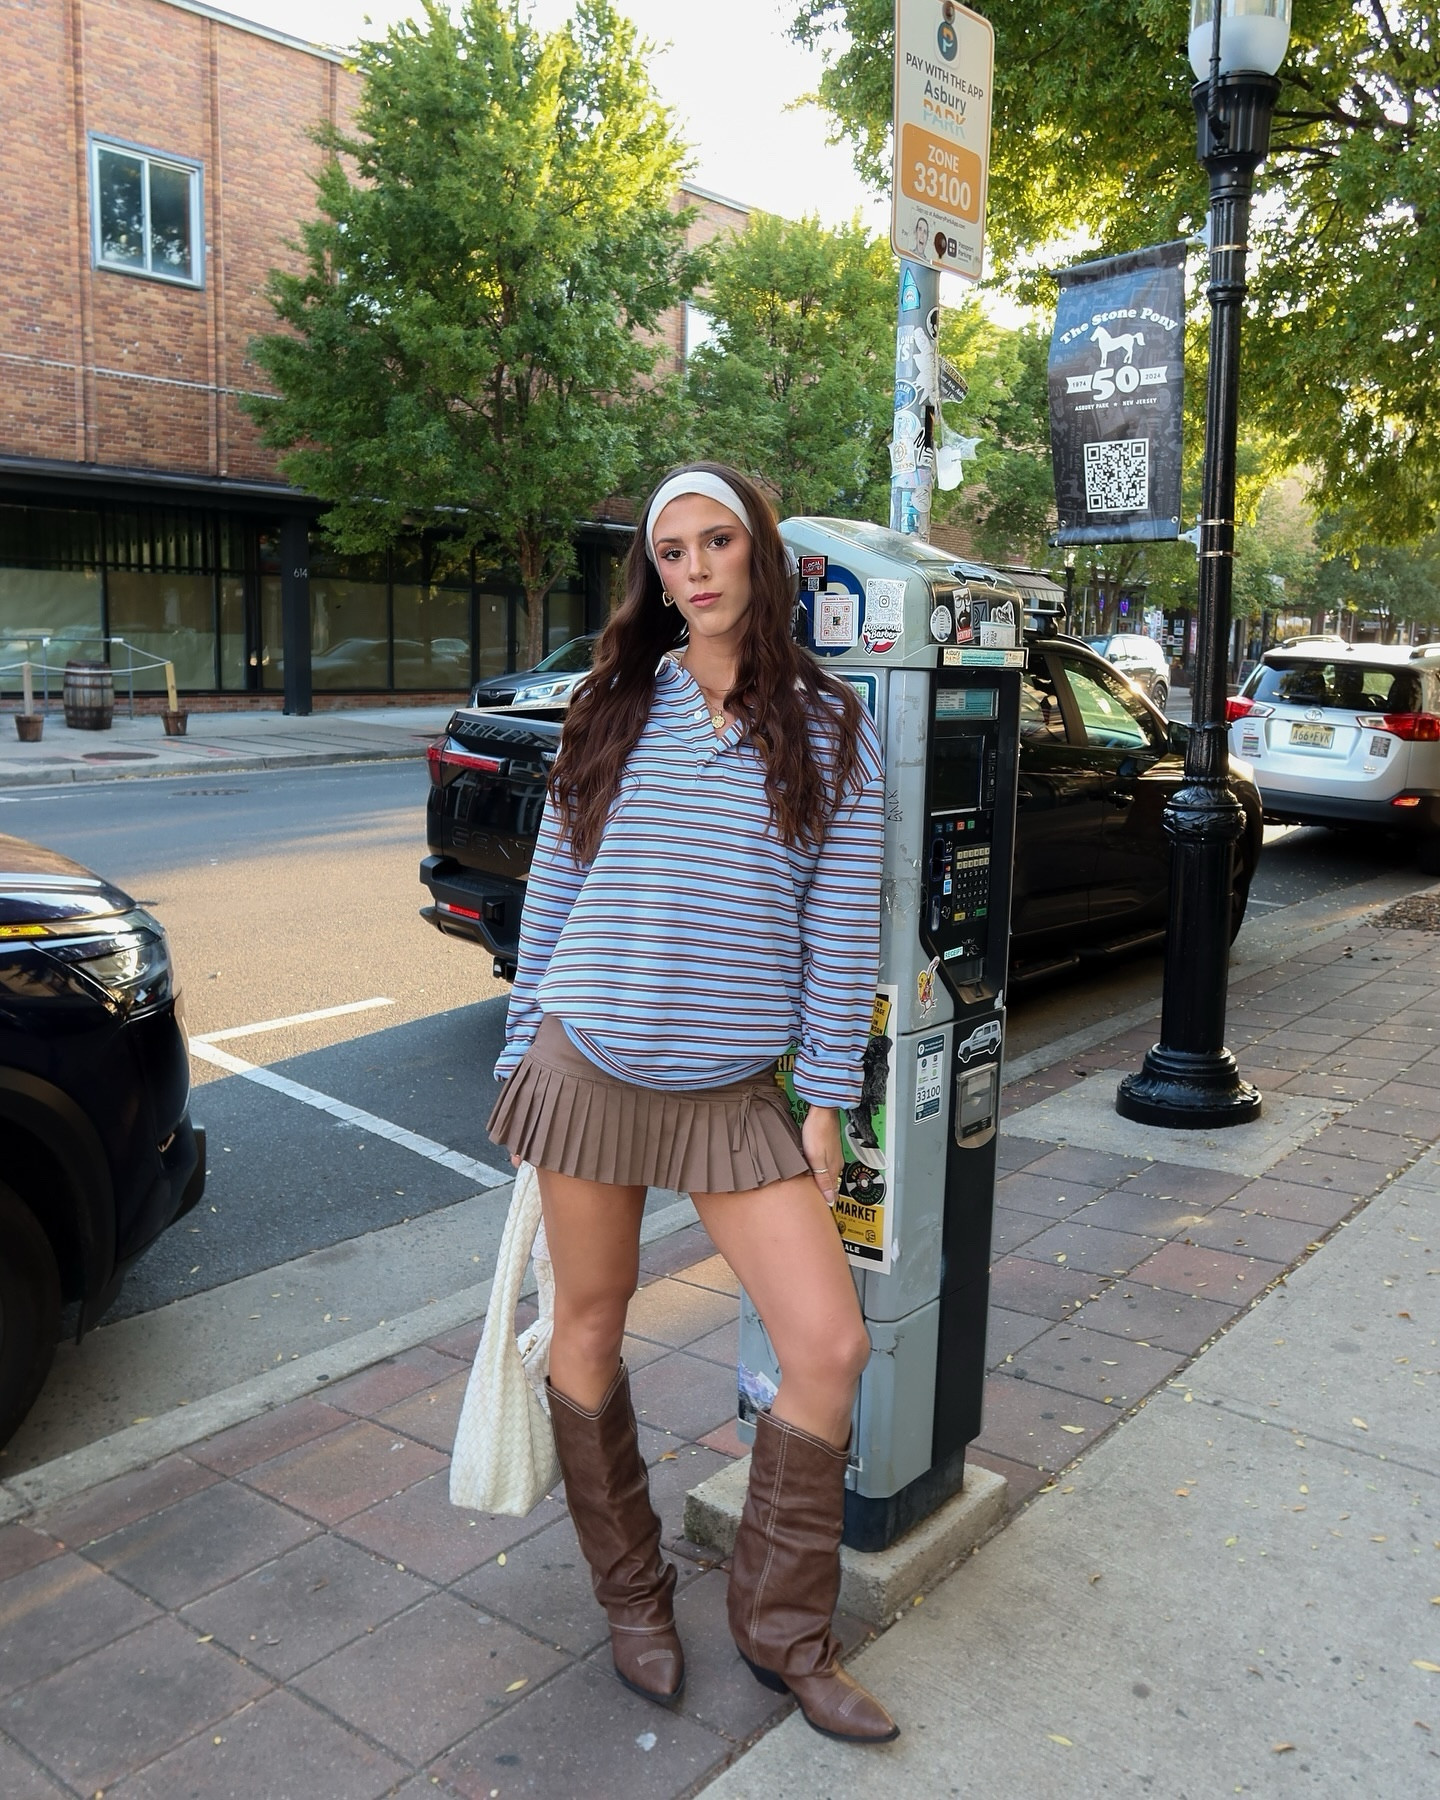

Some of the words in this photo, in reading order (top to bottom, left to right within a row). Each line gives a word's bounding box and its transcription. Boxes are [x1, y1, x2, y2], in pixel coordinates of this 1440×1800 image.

[906, 52, 923, 71] PAY
[925, 61, 949, 84] WITH
[950, 74, 966, 93] THE
[967, 84, 984, 100] APP
[924, 80, 967, 116] Asbury
[922, 98, 967, 139] PARK
[928, 144, 960, 173] ZONE
[914, 162, 971, 211] 33100
[1060, 323, 1089, 345] The
[1092, 309, 1137, 326] Stone
[1140, 307, 1179, 331] Pony
[1072, 380, 1087, 388] 1974
[1092, 365, 1140, 401] 50
[1074, 404, 1095, 412] ASBURY
[1095, 402, 1110, 410] PARK
[1135, 397, 1157, 406] JERSEY
[293, 567, 308, 578] 614
[870, 630, 897, 640] Barber
[917, 1085, 940, 1103] 33100
[836, 1201, 877, 1223] MARKET
